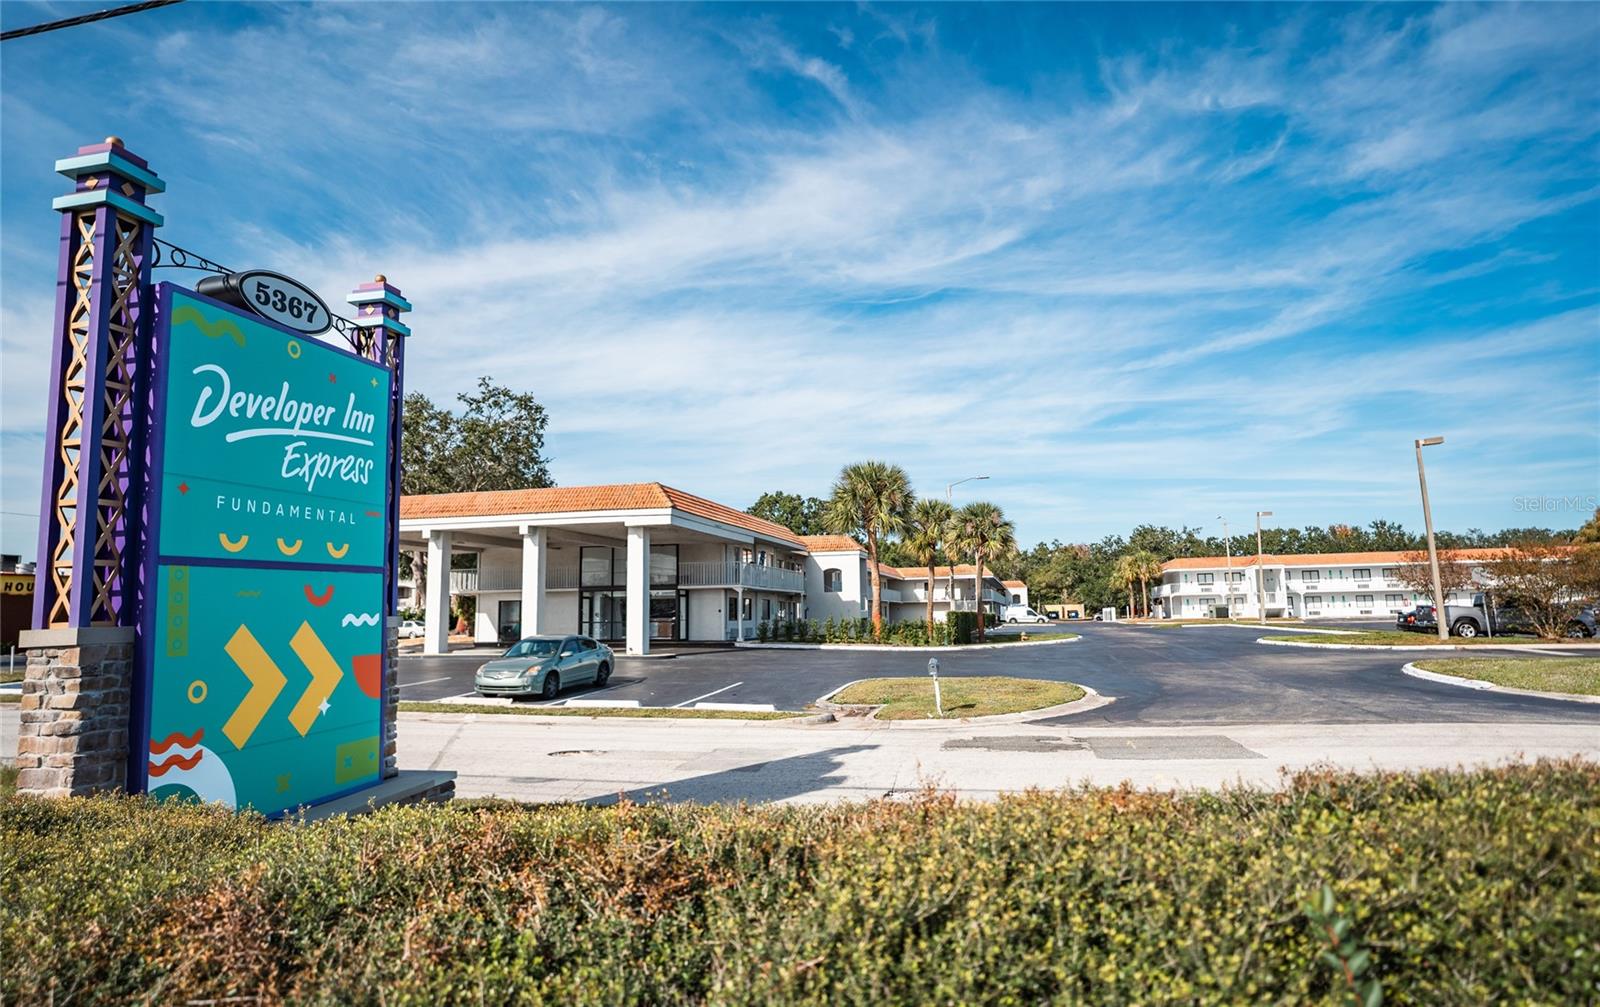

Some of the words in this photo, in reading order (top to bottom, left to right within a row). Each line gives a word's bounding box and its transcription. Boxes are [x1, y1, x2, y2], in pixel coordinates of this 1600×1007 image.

[255, 281, 318, 324] 5367
[191, 364, 336, 435] Developer
[343, 392, 375, 434] Inn
[281, 441, 374, 492] Express
[216, 495, 357, 524] FUNDAMENTAL
